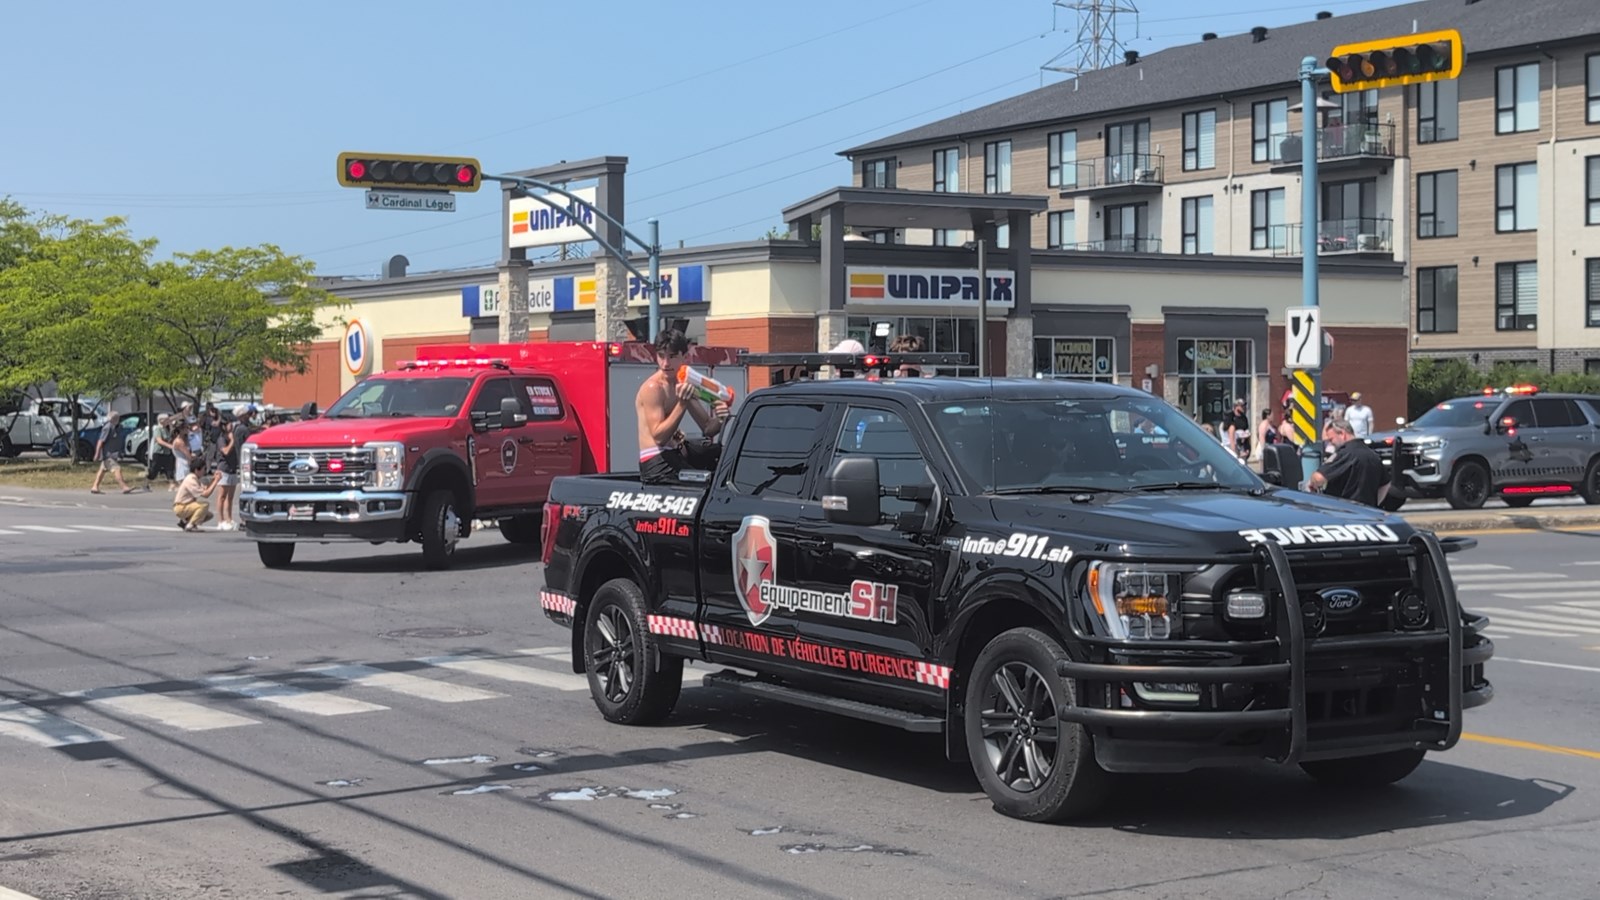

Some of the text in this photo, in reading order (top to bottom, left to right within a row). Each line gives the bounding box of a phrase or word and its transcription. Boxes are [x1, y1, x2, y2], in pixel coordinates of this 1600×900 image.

[382, 197, 453, 210] Cardinal Léger
[606, 491, 698, 515] 514-296-5413
[962, 532, 1073, 563] info@911.sh
[1329, 594, 1354, 610] Ford
[721, 628, 916, 680] LOCATION DE VÉHICULES D'URGENCE
